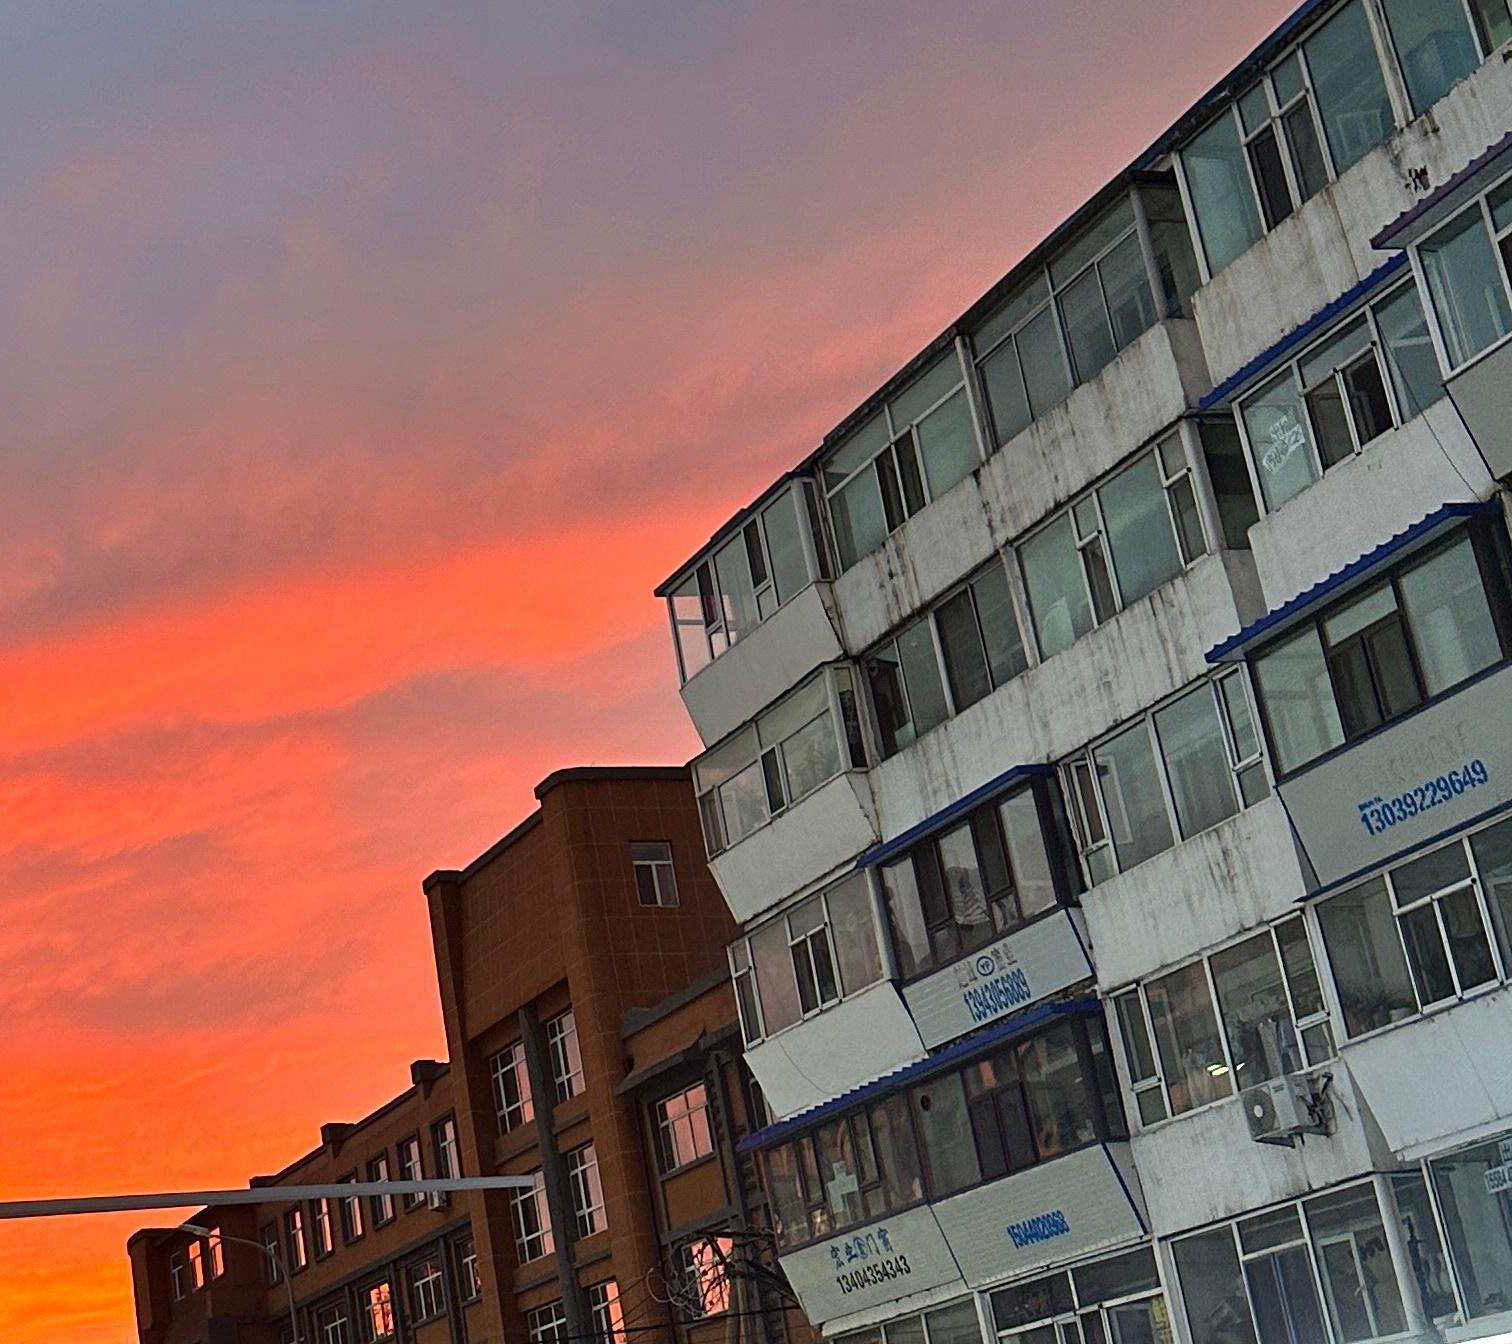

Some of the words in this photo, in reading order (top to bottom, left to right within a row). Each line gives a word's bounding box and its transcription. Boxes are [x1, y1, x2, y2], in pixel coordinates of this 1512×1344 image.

[1360, 759, 1489, 836] 13039229649
[963, 967, 1031, 1023] 13943056889
[836, 1254, 911, 1295] 13404354343
